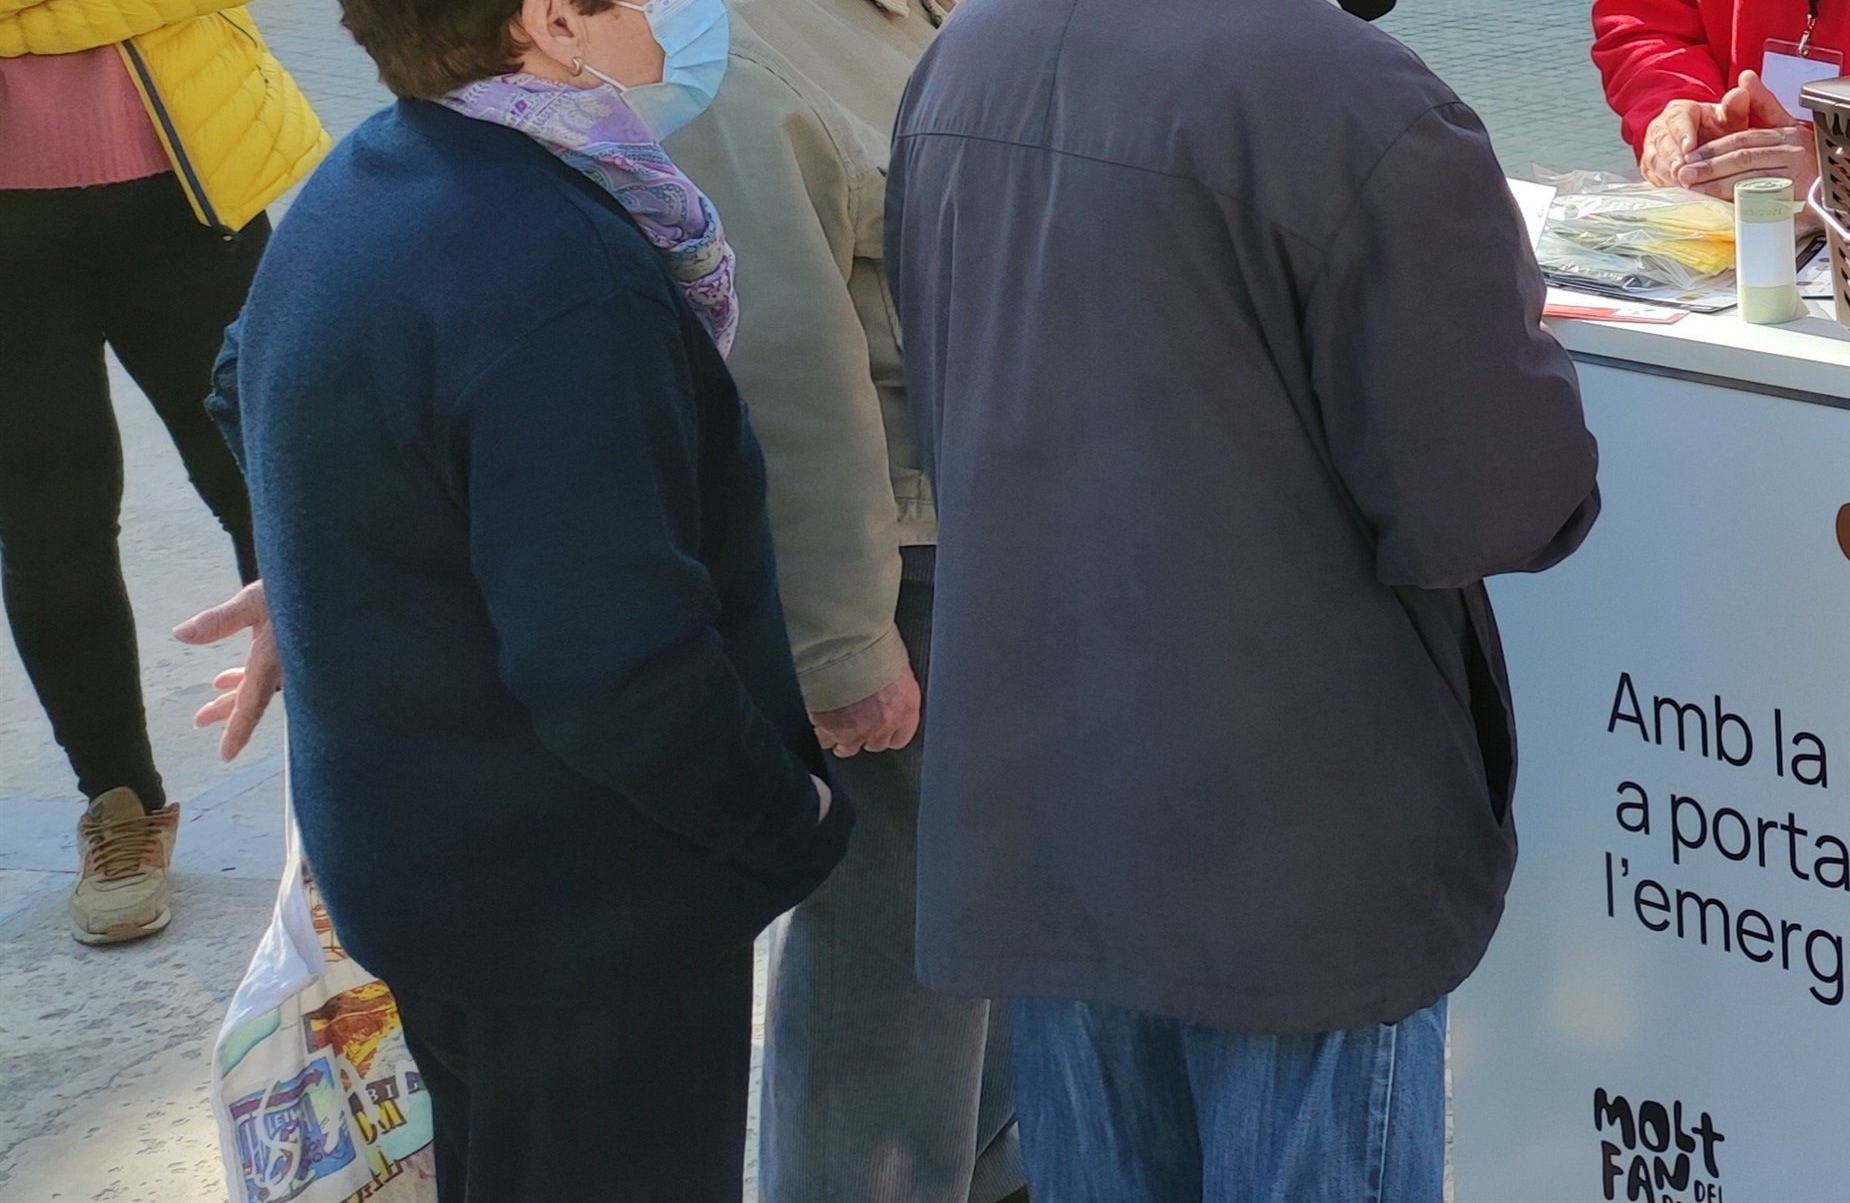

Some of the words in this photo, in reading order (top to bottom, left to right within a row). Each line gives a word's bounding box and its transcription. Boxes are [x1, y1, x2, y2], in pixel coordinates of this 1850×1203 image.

[1606, 671, 1754, 768] Amb
[1772, 707, 1828, 790] la
[1614, 780, 1650, 835] a
[1669, 792, 1850, 891] porta
[1594, 1087, 1725, 1179] MOLT
[1601, 1140, 1691, 1203] FAN
